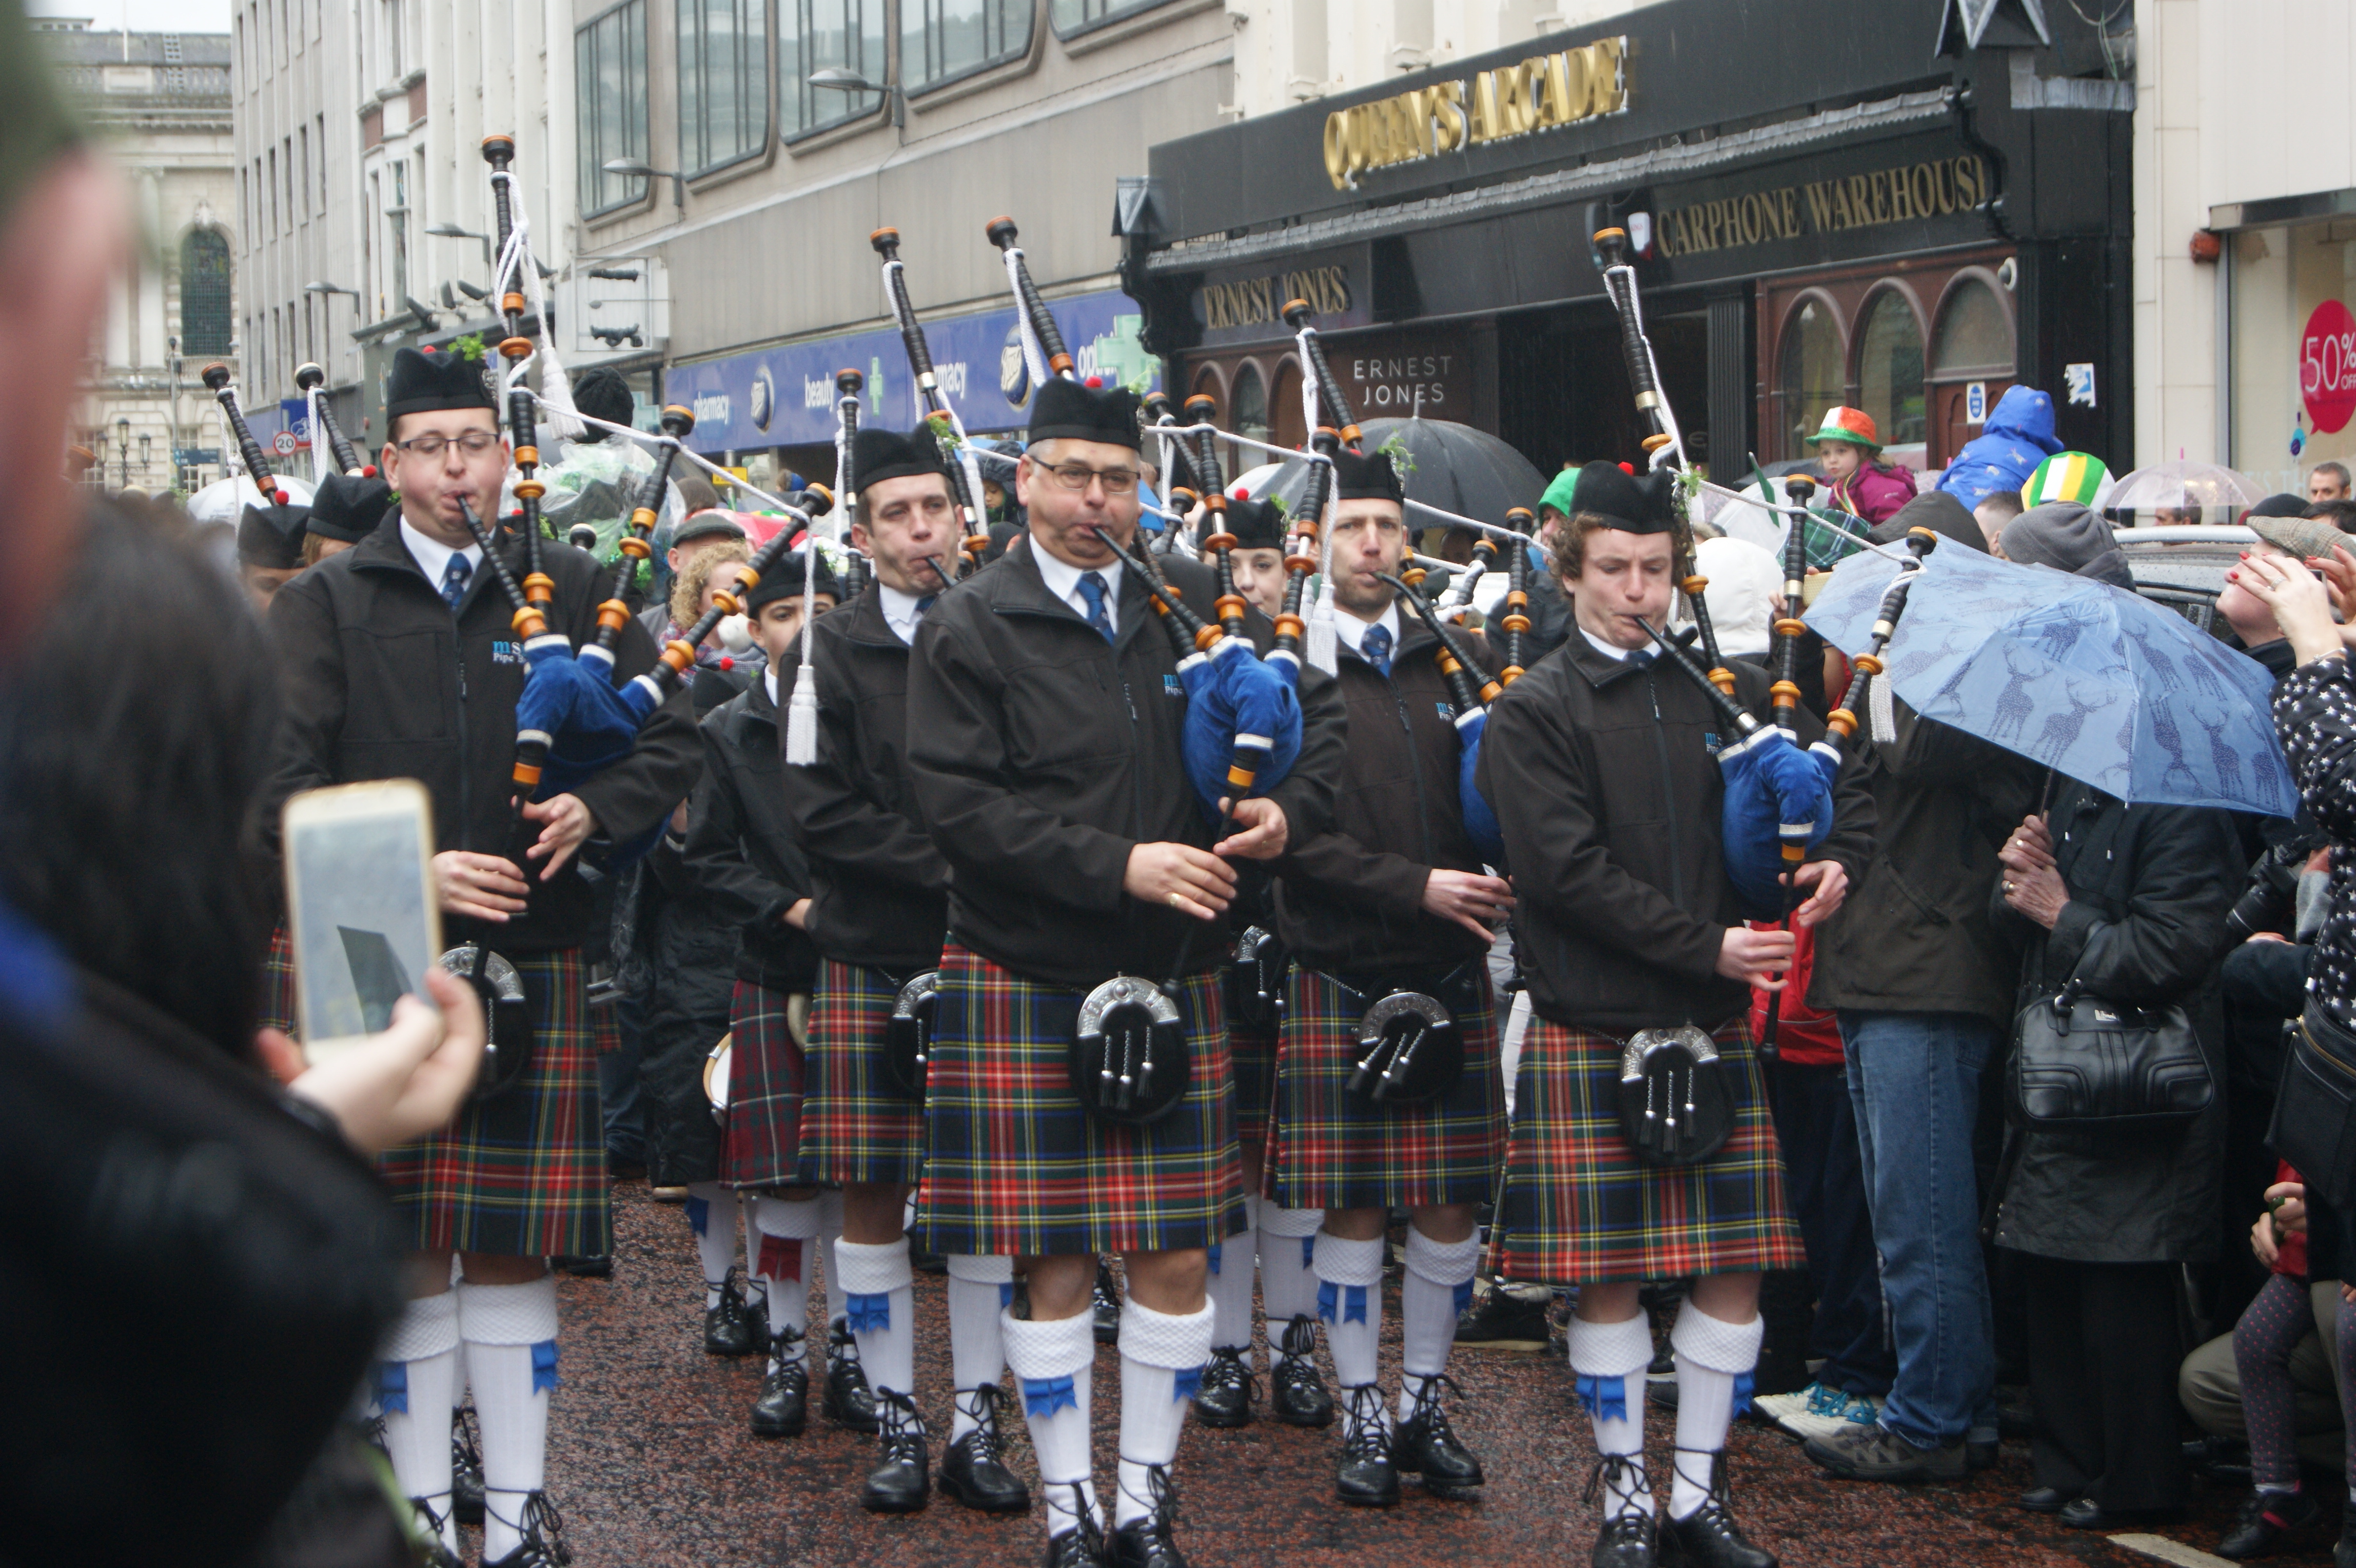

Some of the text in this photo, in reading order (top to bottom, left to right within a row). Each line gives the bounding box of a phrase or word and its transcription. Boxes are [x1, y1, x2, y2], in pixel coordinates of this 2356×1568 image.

[1324, 35, 1627, 190] QUEEN'S ARCADE
[1657, 186, 1800, 258] CARPHONE
[1203, 265, 1348, 329] ERNEST JONES
[1354, 356, 1451, 379] ERNEST
[2304, 331, 2356, 393] 50%
[694, 391, 729, 428] pharmacy
[805, 372, 835, 412] beauty
[1363, 382, 1444, 405] JONES
[278, 438, 294, 448] 20
[493, 652, 514, 663] Pipe
